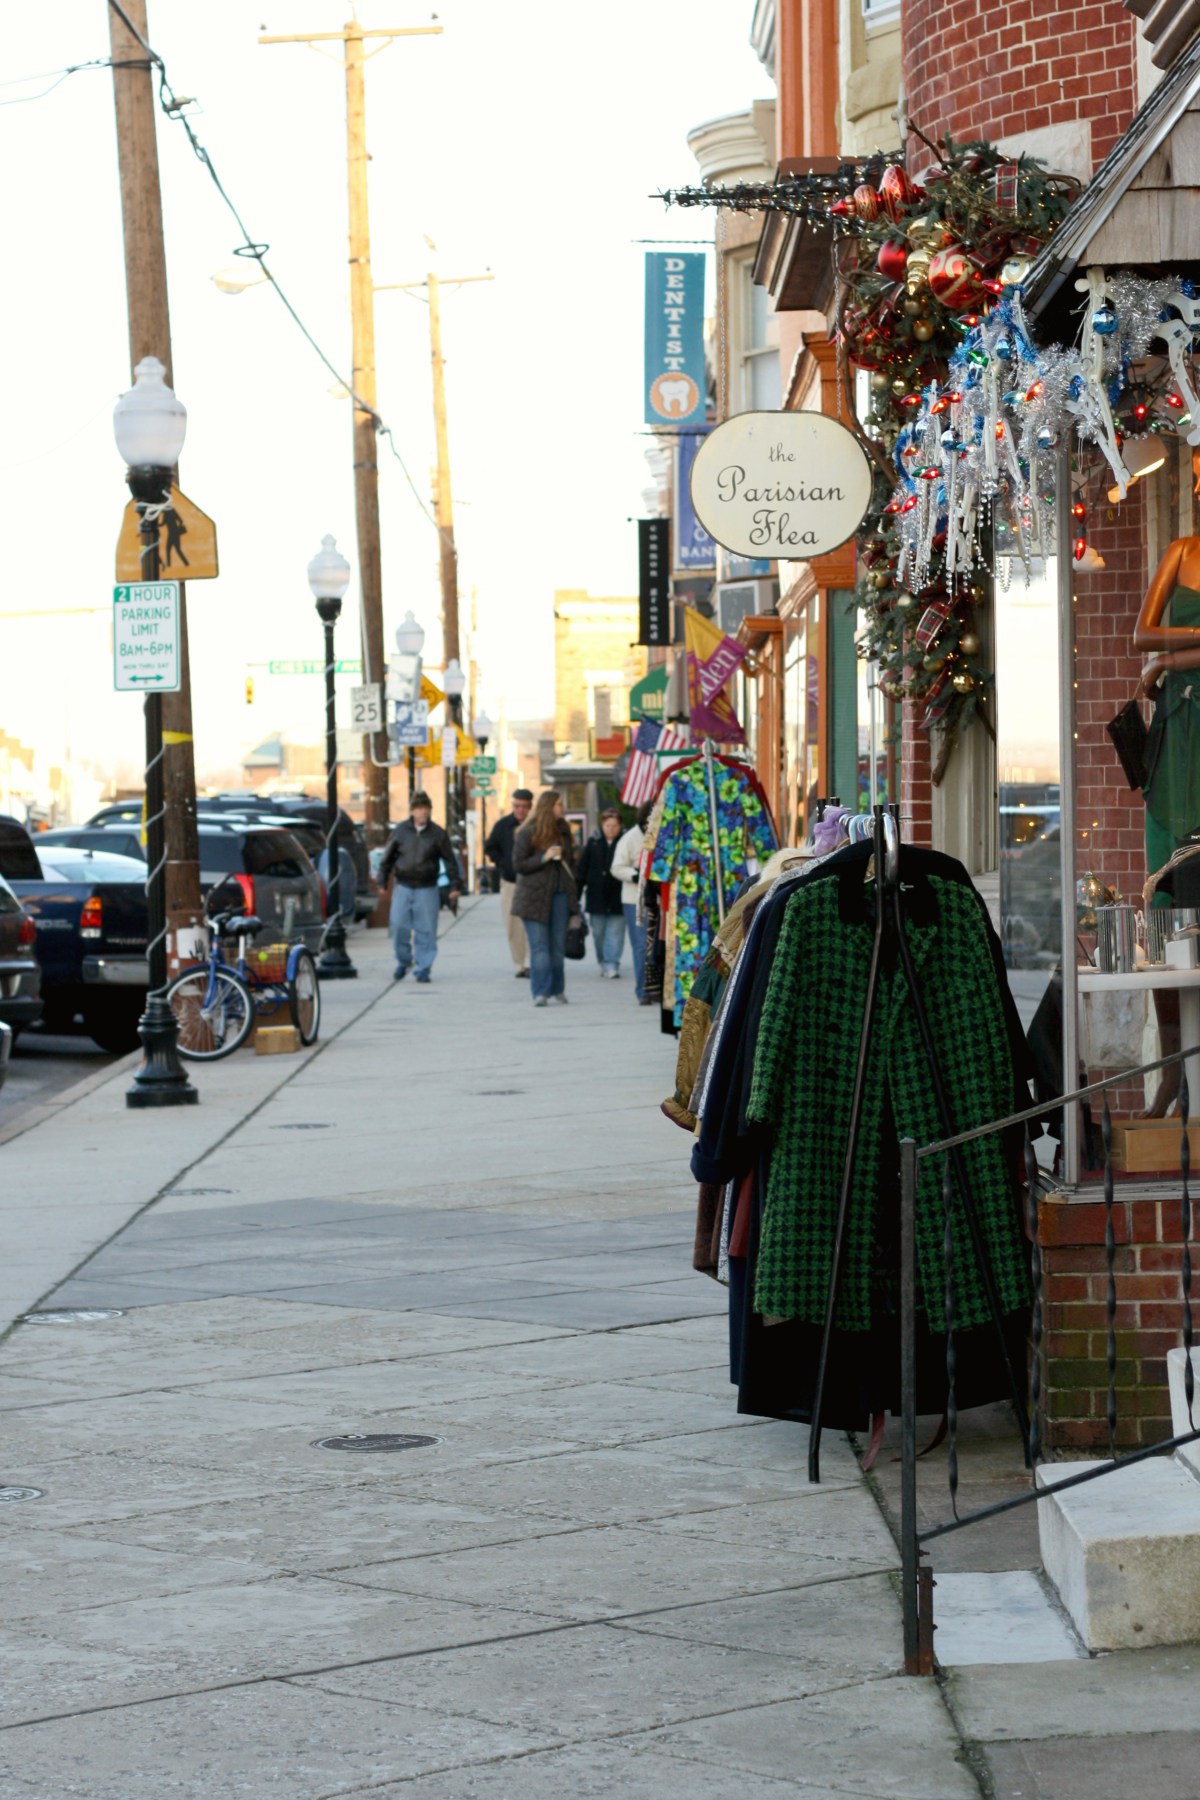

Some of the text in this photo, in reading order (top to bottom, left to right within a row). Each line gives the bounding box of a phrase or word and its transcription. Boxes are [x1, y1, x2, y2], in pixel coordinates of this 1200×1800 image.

[664, 258, 685, 370] DENTIST
[768, 442, 796, 462] the
[717, 465, 846, 502] Parisian
[749, 509, 819, 546] Flea
[680, 546, 716, 558] BAN
[118, 587, 171, 601] 2 HOUR
[121, 606, 171, 621] PARKING
[131, 623, 159, 636] LIMIT
[119, 641, 173, 657] 8AM-6PM
[354, 702, 378, 722] 25
